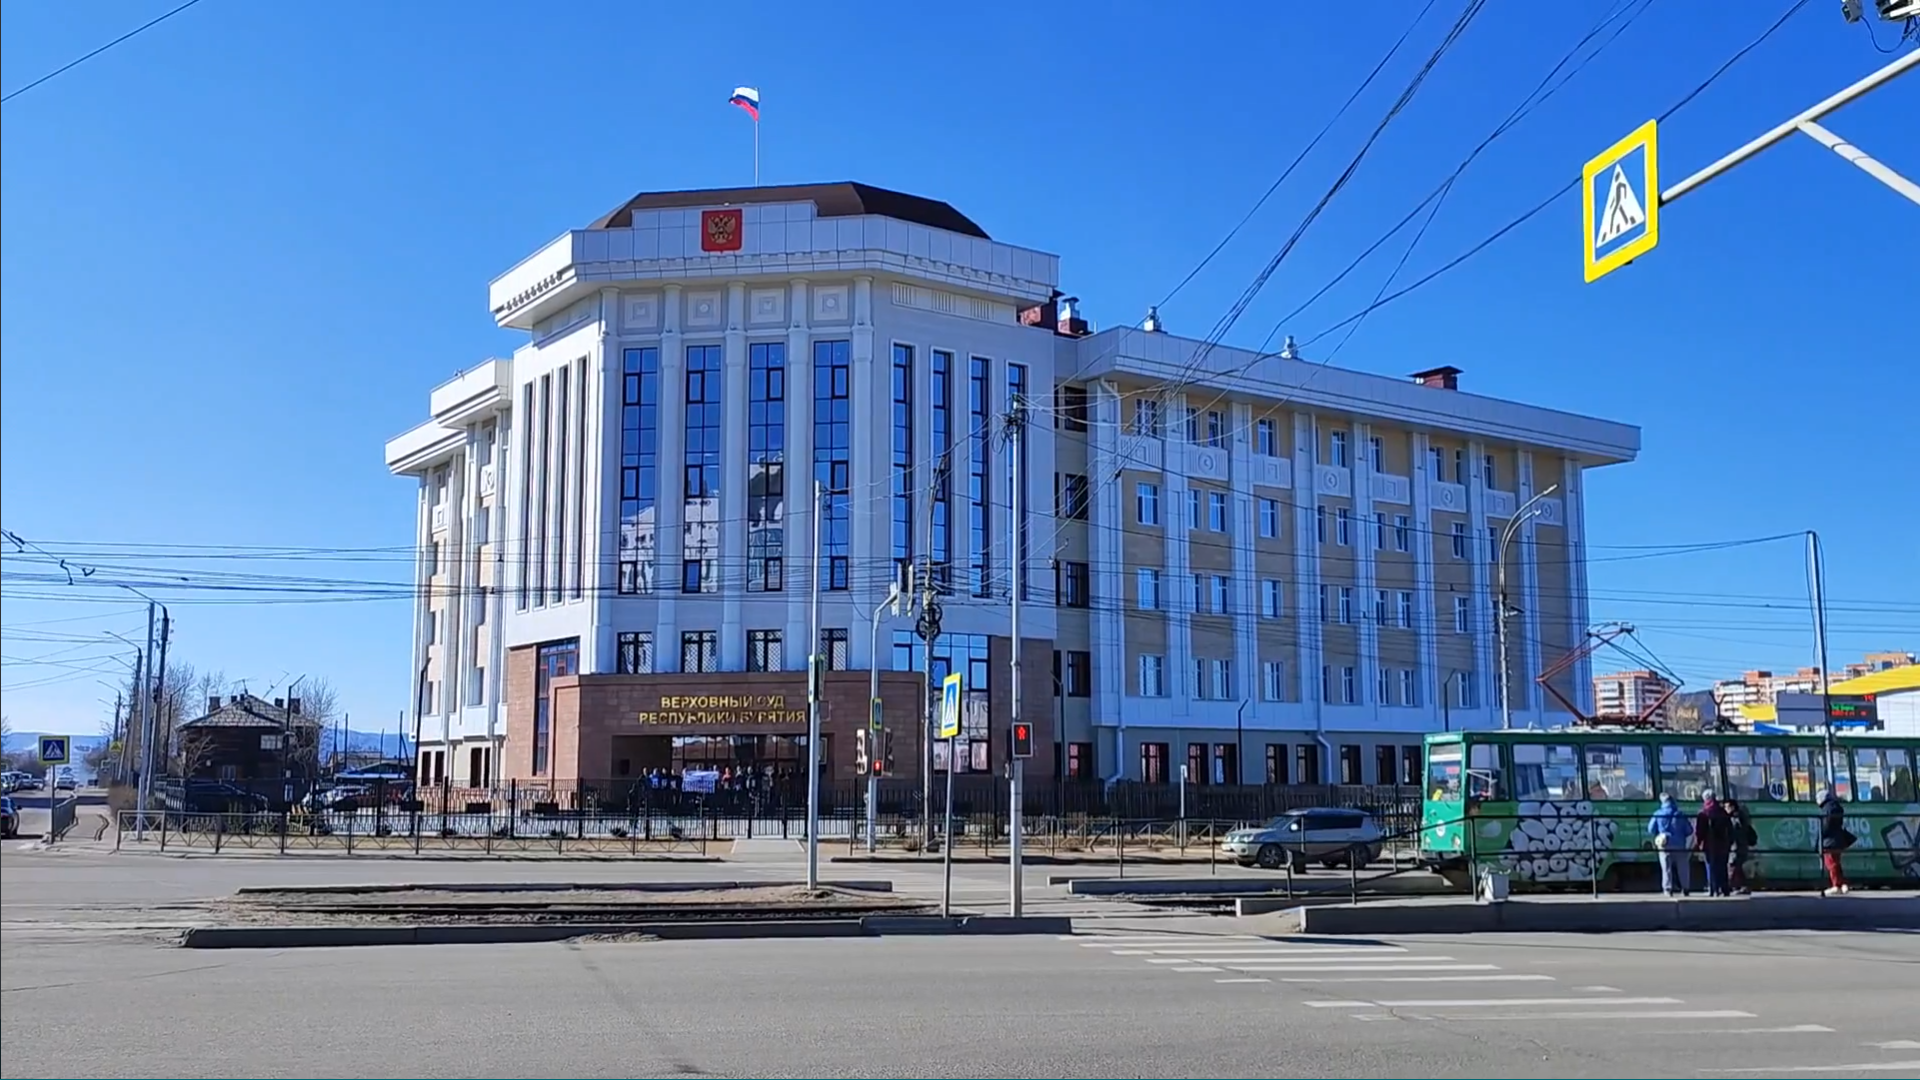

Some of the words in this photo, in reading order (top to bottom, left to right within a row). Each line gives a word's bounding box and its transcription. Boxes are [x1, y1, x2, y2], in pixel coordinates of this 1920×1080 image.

[661, 694, 753, 708] ВЕРХОВНЫЙ
[757, 695, 785, 709] СУД
[639, 711, 735, 724] РЕСПУБЛИКИ
[740, 711, 805, 723] БУРЯТИЯ
[1772, 783, 1784, 797] 40
